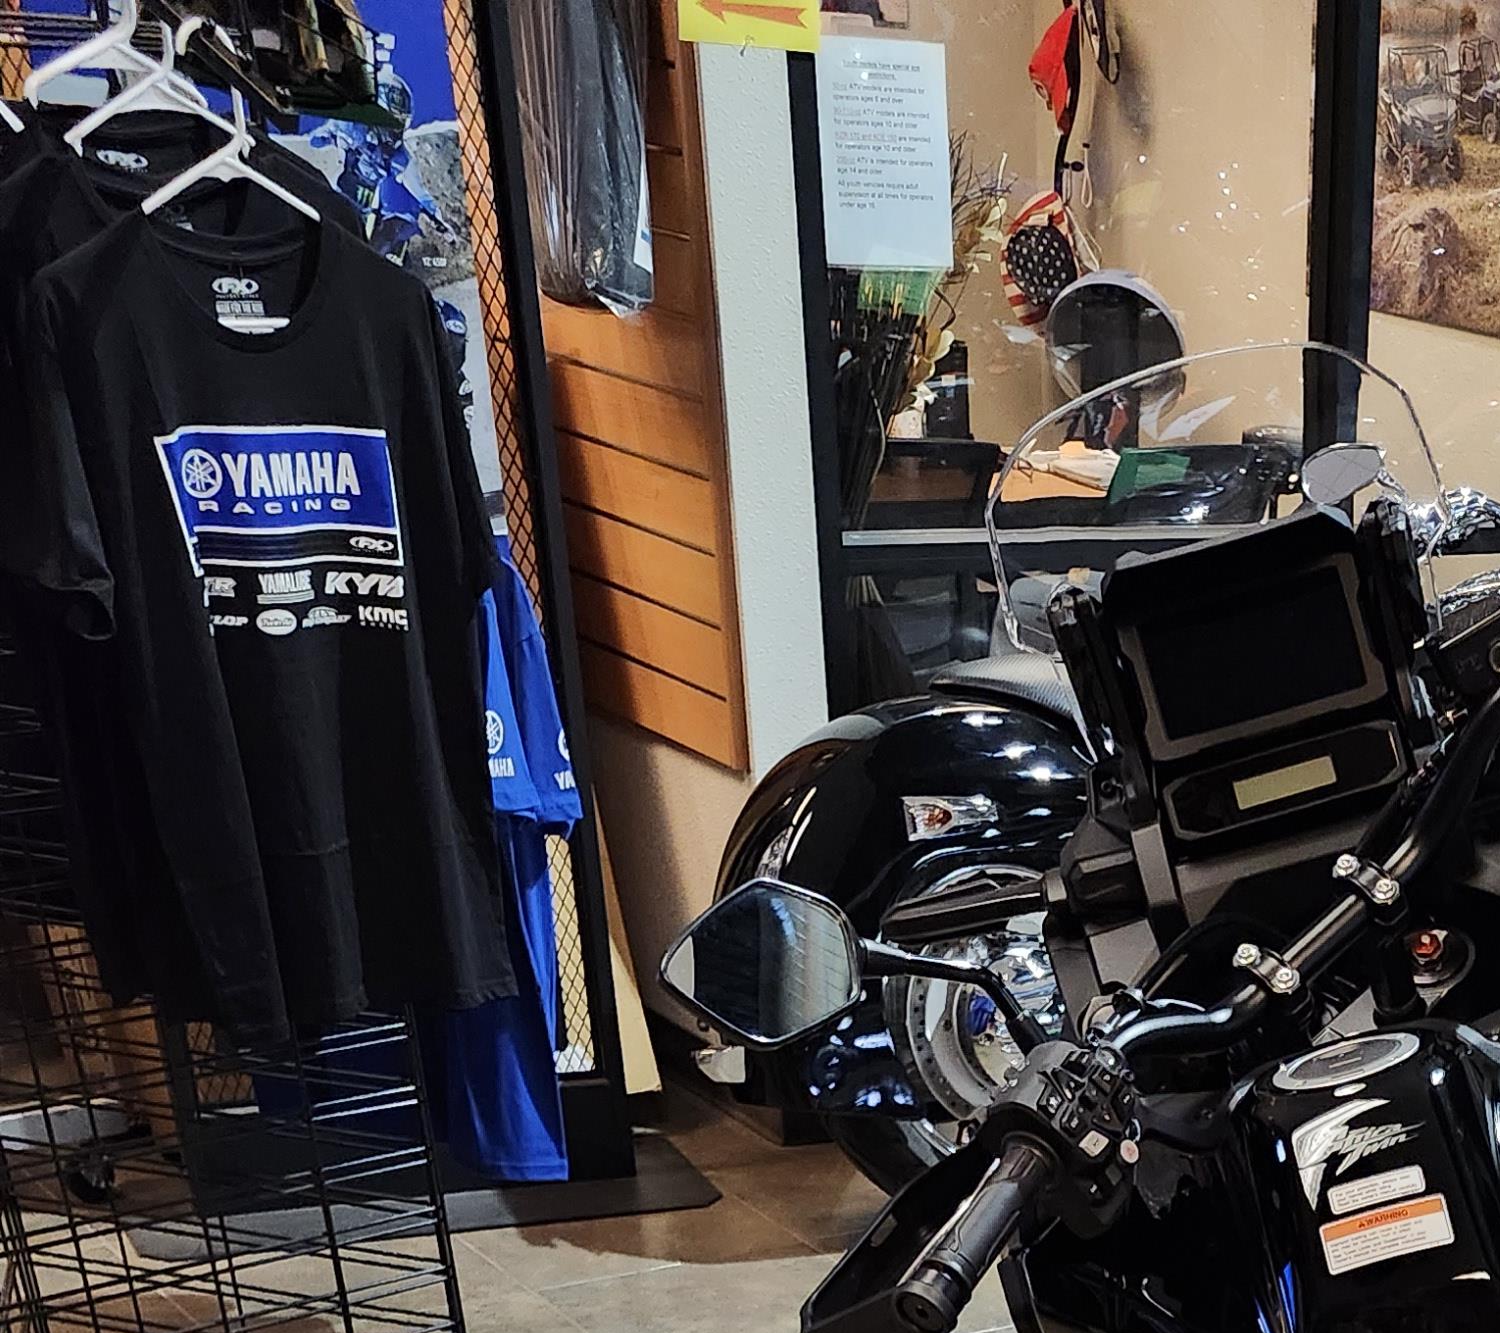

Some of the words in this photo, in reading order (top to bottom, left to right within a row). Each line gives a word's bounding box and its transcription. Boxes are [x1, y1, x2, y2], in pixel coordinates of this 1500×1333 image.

[221, 451, 361, 497] YAMAHA
[198, 498, 351, 514] RACING
[1366, 1208, 1409, 1227] WARNING
